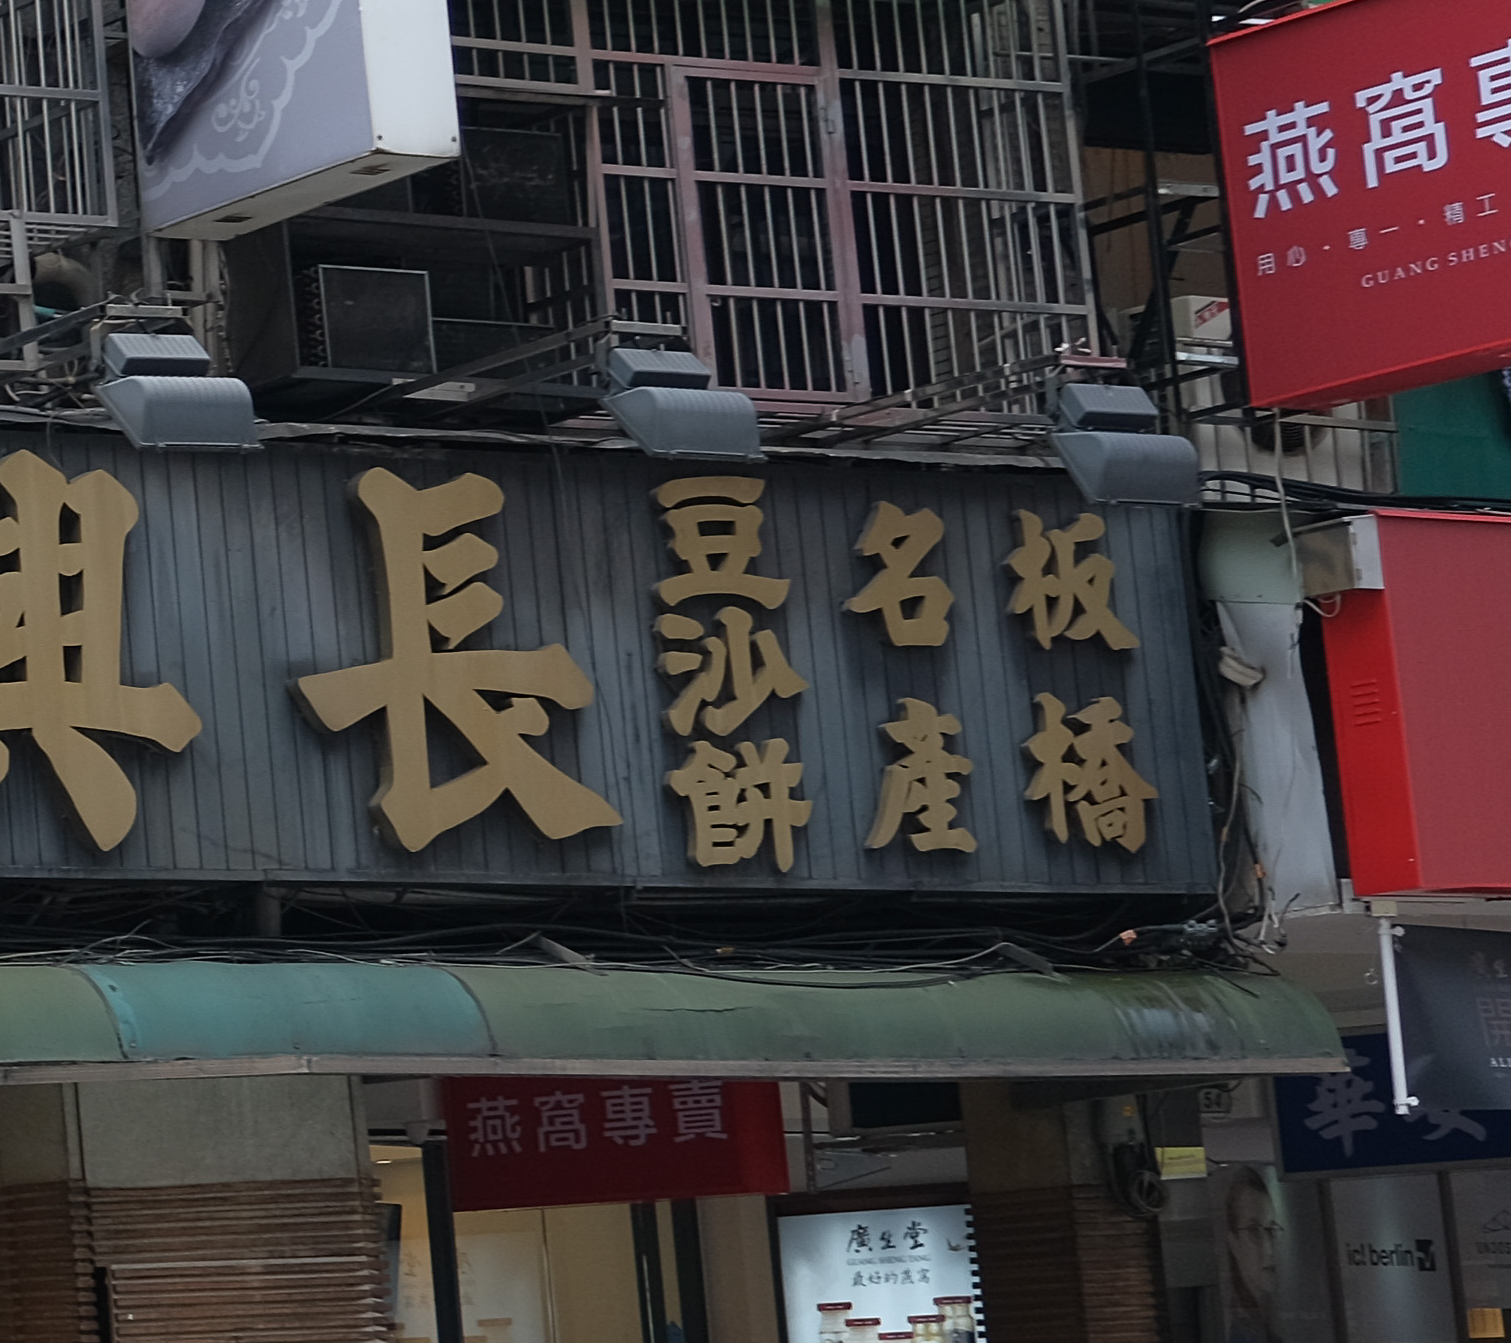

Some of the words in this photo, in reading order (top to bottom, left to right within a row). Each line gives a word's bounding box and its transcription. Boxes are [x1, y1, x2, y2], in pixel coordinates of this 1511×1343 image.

[1361, 257, 1439, 288] GUANG
[653, 477, 812, 873] 豆沙餅
[846, 499, 977, 855] 名產
[1006, 509, 1159, 855] 板橋
[467, 1078, 728, 1154] 燕窩專賣
[1369, 1243, 1415, 1268] berlin
